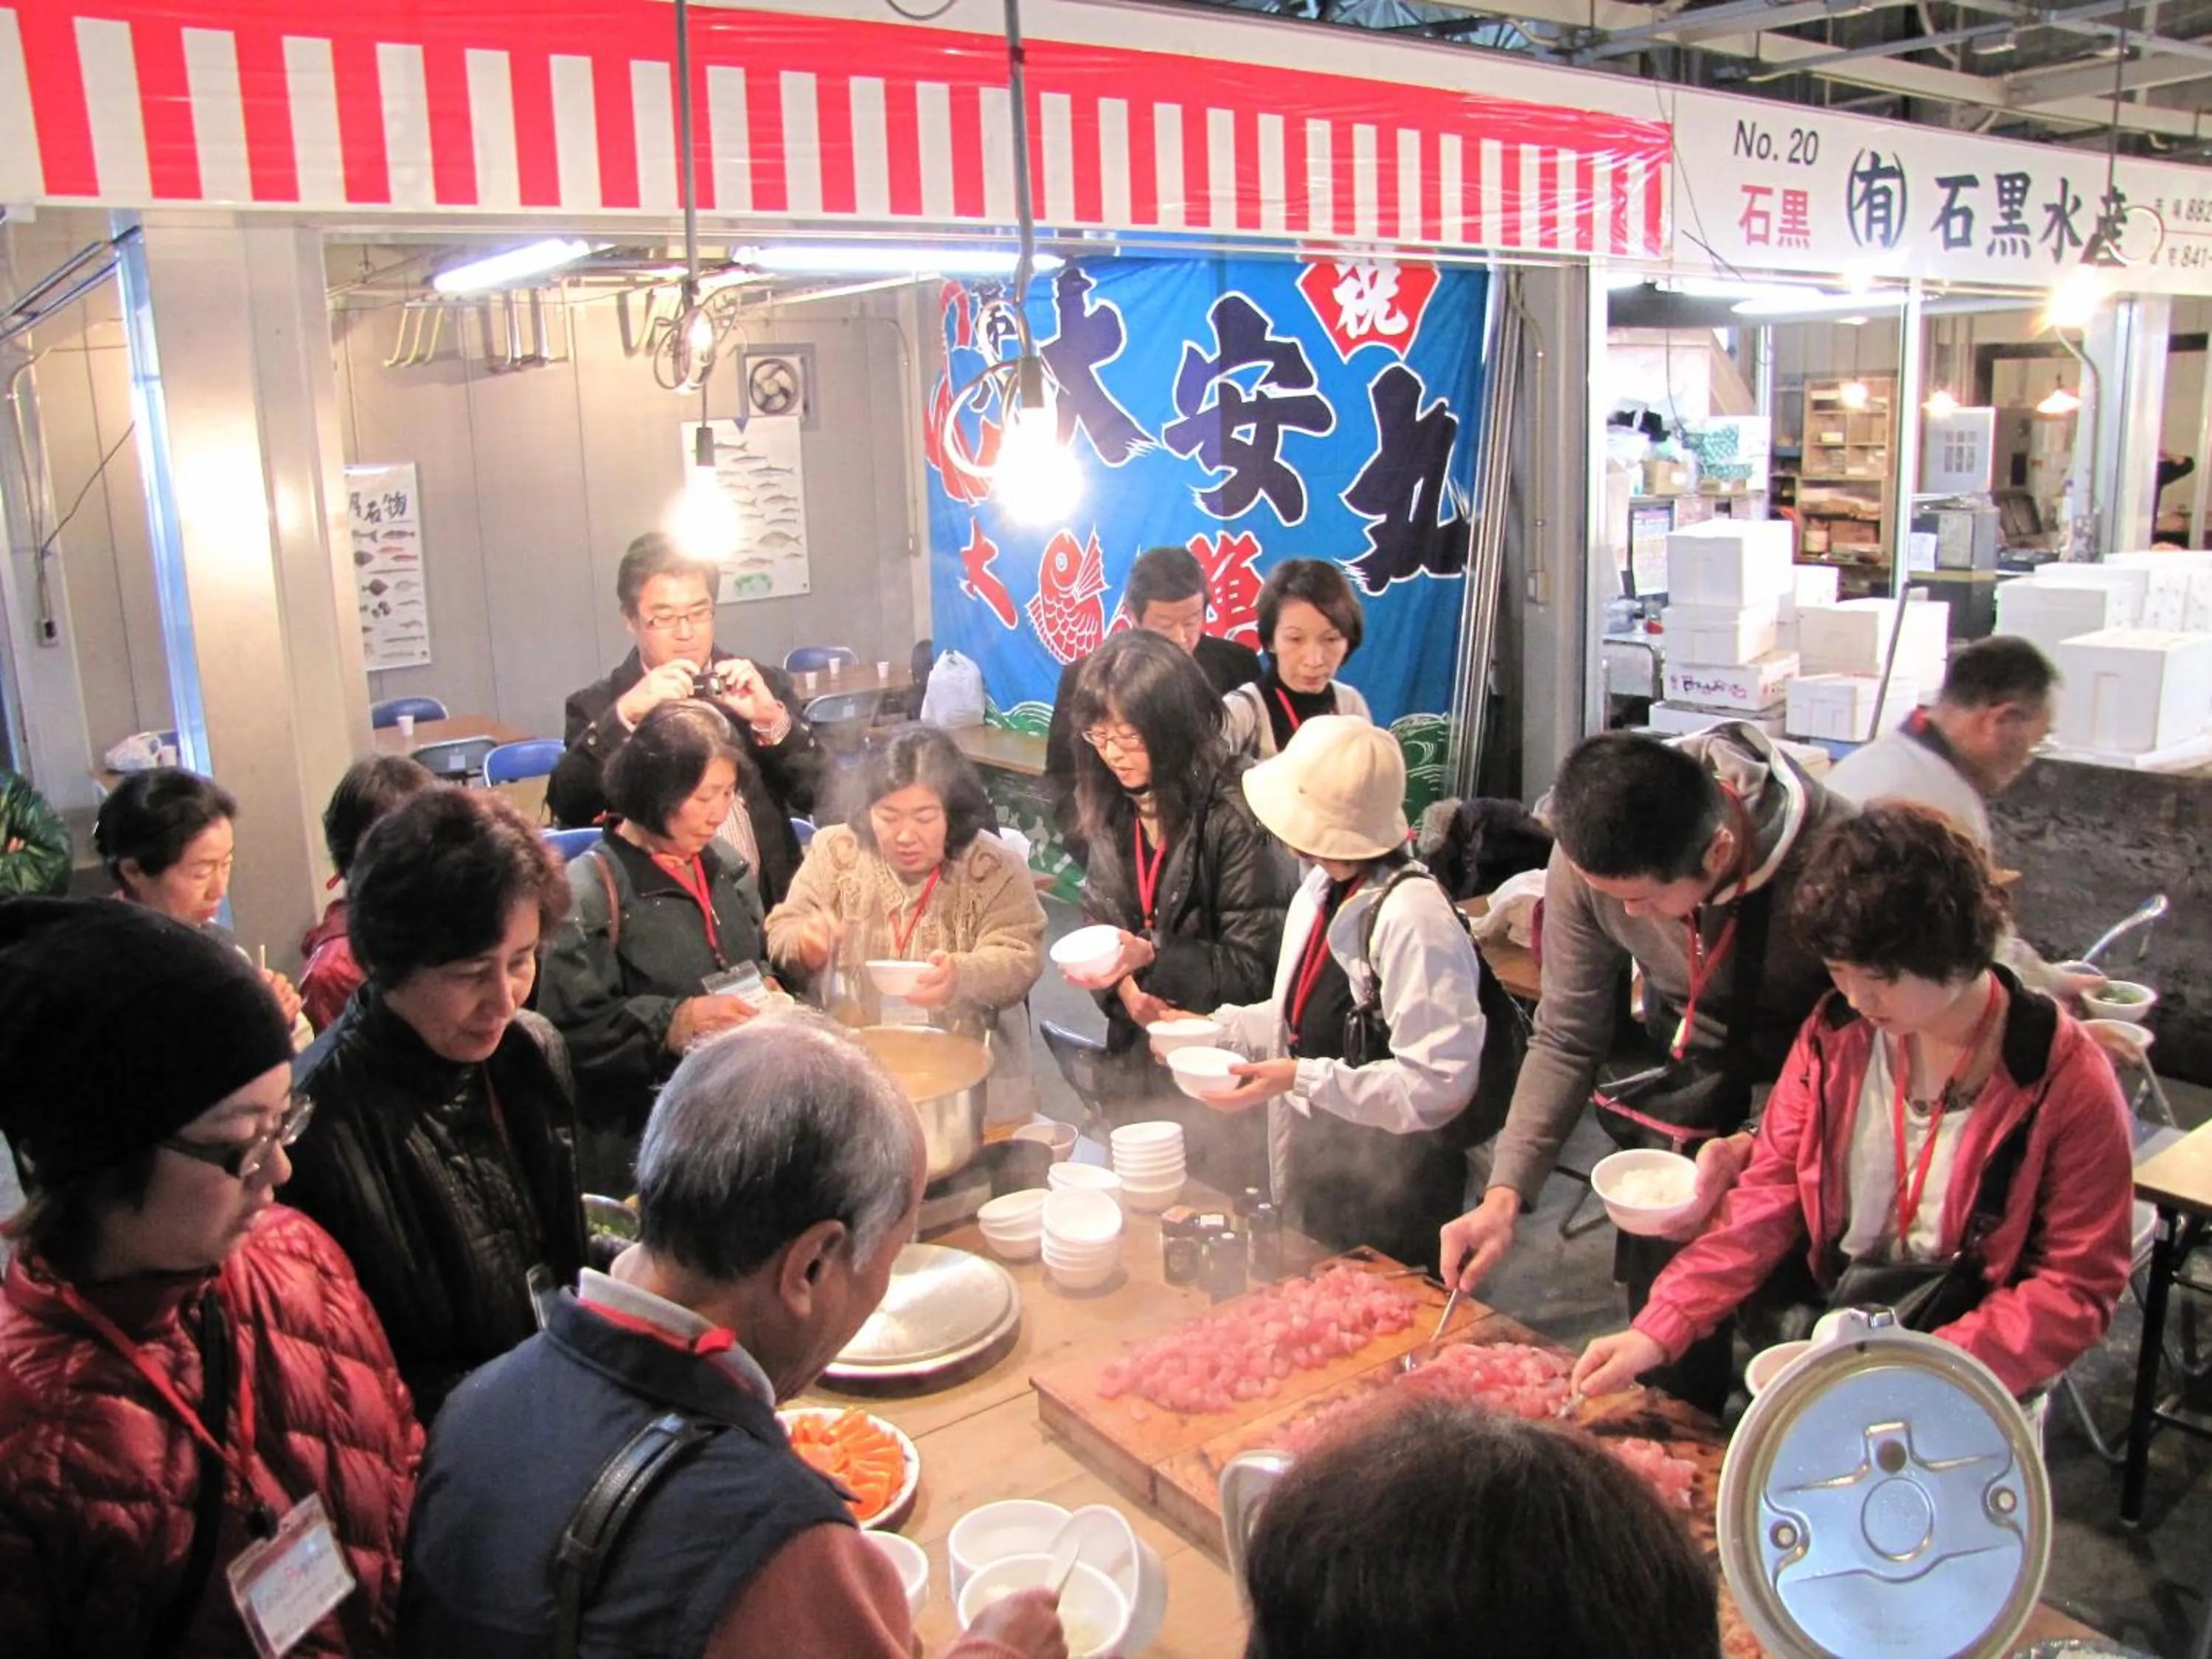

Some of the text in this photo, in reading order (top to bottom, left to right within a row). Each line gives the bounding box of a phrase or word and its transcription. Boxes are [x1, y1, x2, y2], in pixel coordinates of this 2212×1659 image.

[1733, 119, 1819, 165] No. 20
[1739, 184, 1811, 249] 石黒
[1332, 245, 1410, 339] 祝
